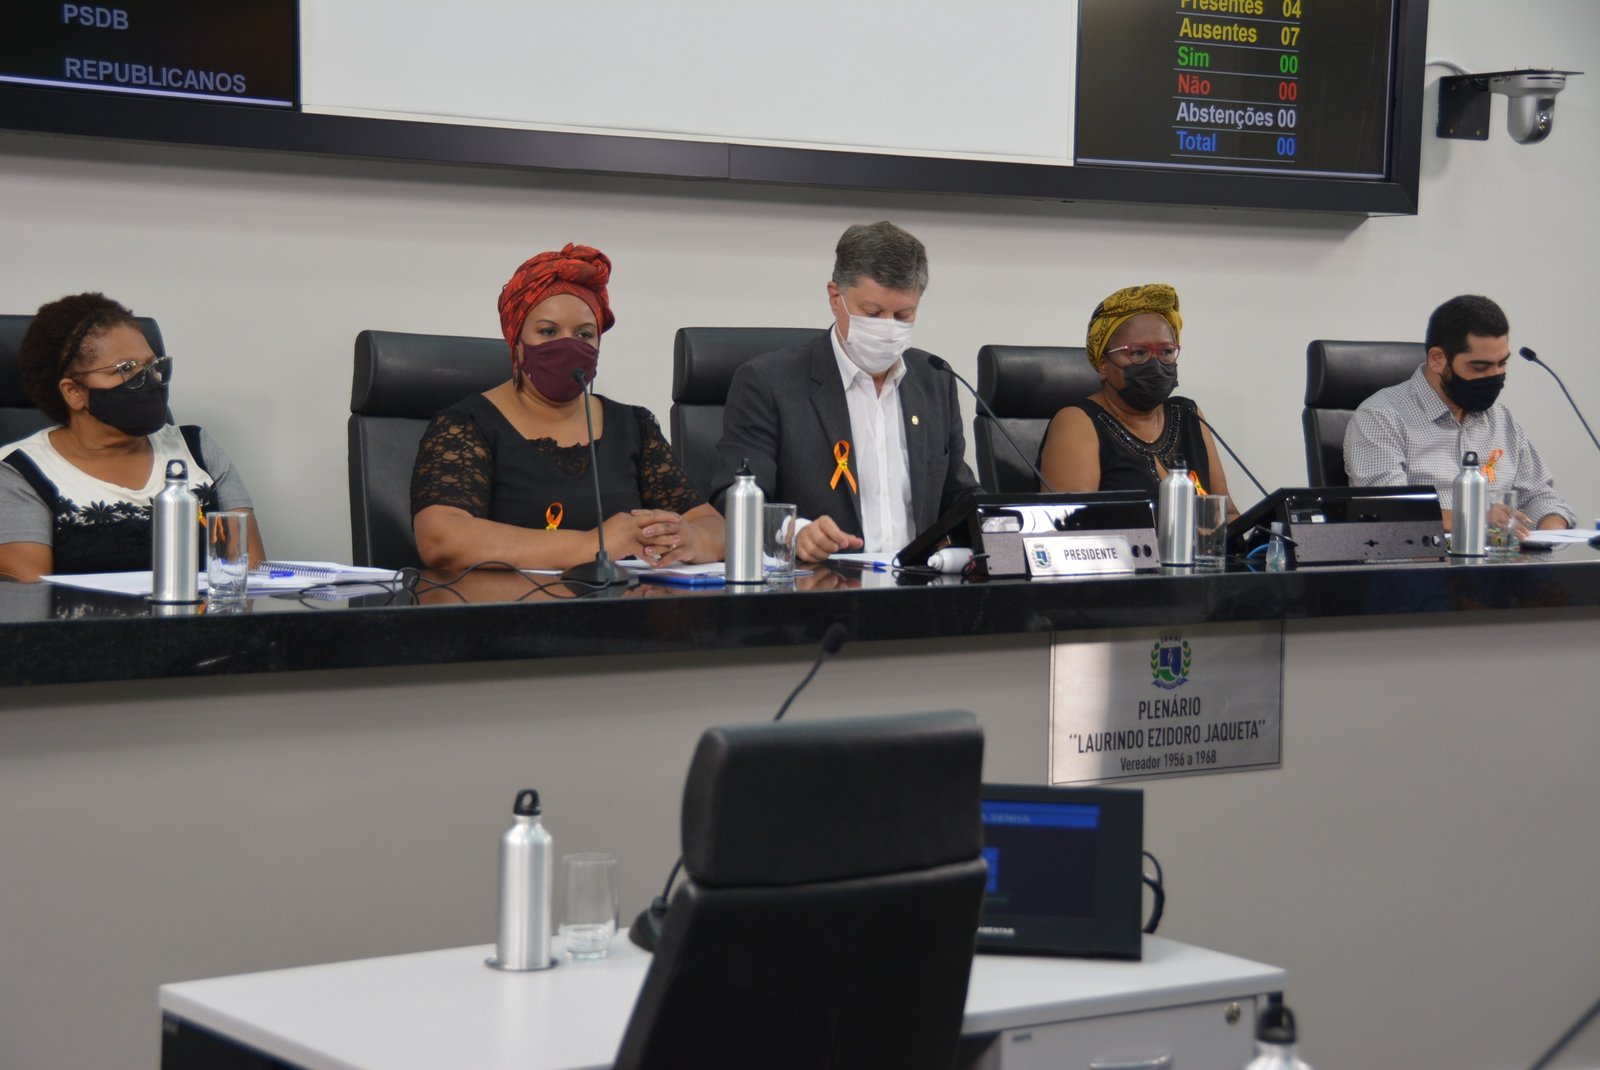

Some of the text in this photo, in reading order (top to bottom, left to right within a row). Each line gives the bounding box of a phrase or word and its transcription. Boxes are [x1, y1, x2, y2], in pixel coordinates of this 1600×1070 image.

[63, 4, 129, 30] PSDB
[1282, 0, 1302, 18] 04
[1179, 17, 1300, 46] Ausentes 07
[1177, 45, 1298, 74] Sim 00
[65, 57, 247, 94] REPUBLICANOS
[1177, 73, 1297, 101] Não 00
[1176, 101, 1296, 130] Abstenções 00
[1176, 131, 1295, 156] Total 00
[1063, 547, 1118, 561] PRESIDENTE
[1138, 693, 1201, 720] PLENÁRIO
[1147, 724, 1200, 748] EZIDORO
[1120, 750, 1217, 772] Vereador 1956 a 1968
